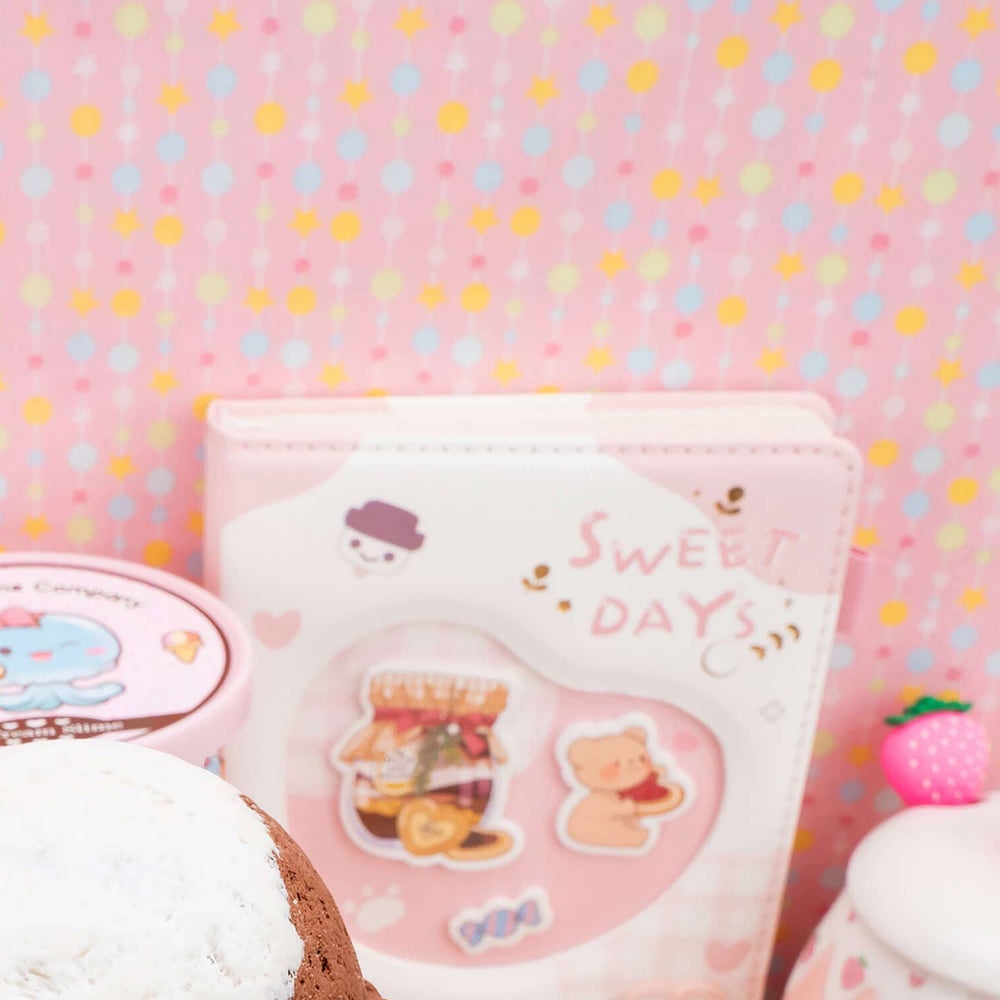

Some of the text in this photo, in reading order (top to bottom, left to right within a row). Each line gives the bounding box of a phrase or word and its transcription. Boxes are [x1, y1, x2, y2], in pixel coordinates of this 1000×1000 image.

[569, 511, 800, 575] SWEET
[34, 580, 142, 608] Company
[590, 591, 757, 639] DAYS
